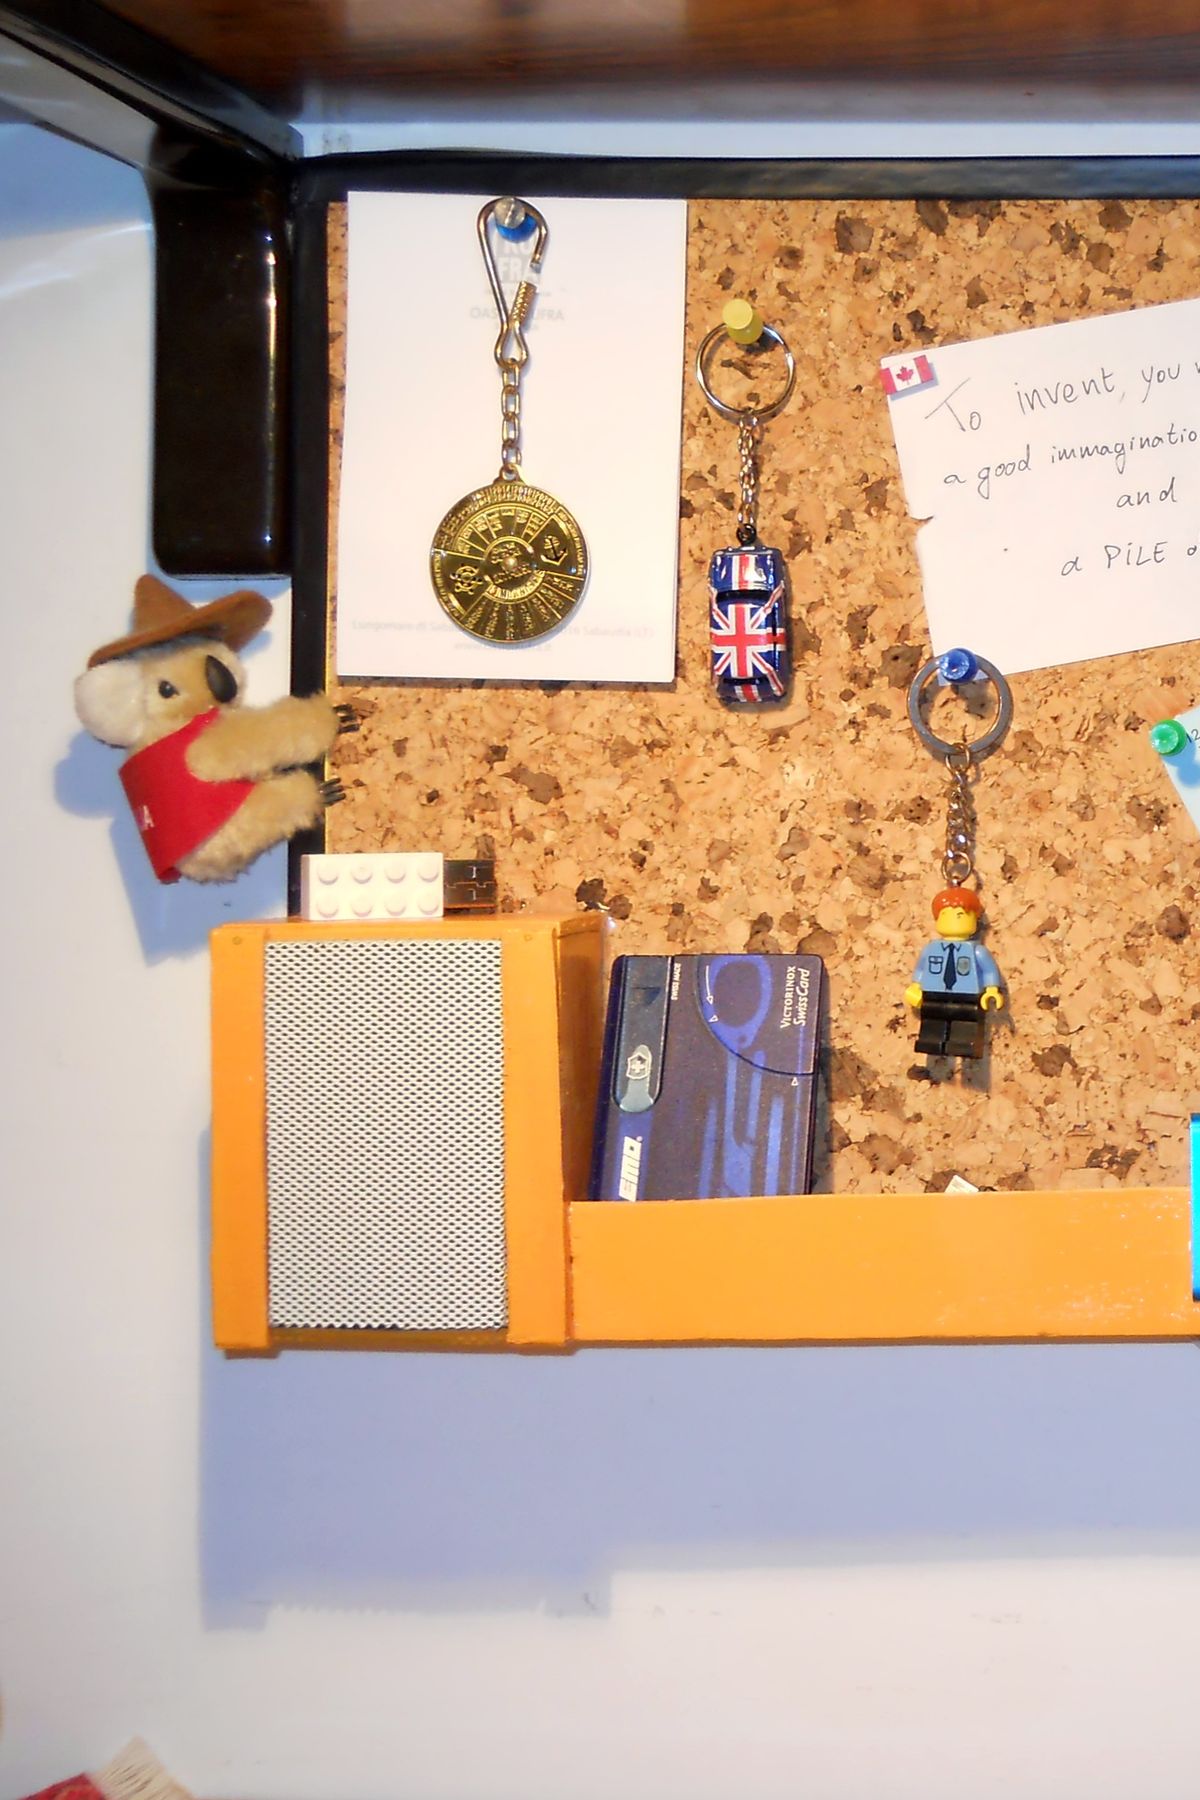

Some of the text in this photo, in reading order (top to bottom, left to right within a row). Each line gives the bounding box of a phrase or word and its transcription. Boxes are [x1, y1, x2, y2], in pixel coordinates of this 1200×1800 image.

[924, 376, 981, 432] To
[1015, 367, 1125, 415] invent,
[1141, 363, 1181, 403] you
[943, 472, 967, 485] a
[977, 444, 1032, 500] good
[1116, 477, 1178, 508] and
[1061, 555, 1083, 577] a
[780, 966, 796, 1029] VICTORINOX
[793, 968, 811, 1027] SwissCard
